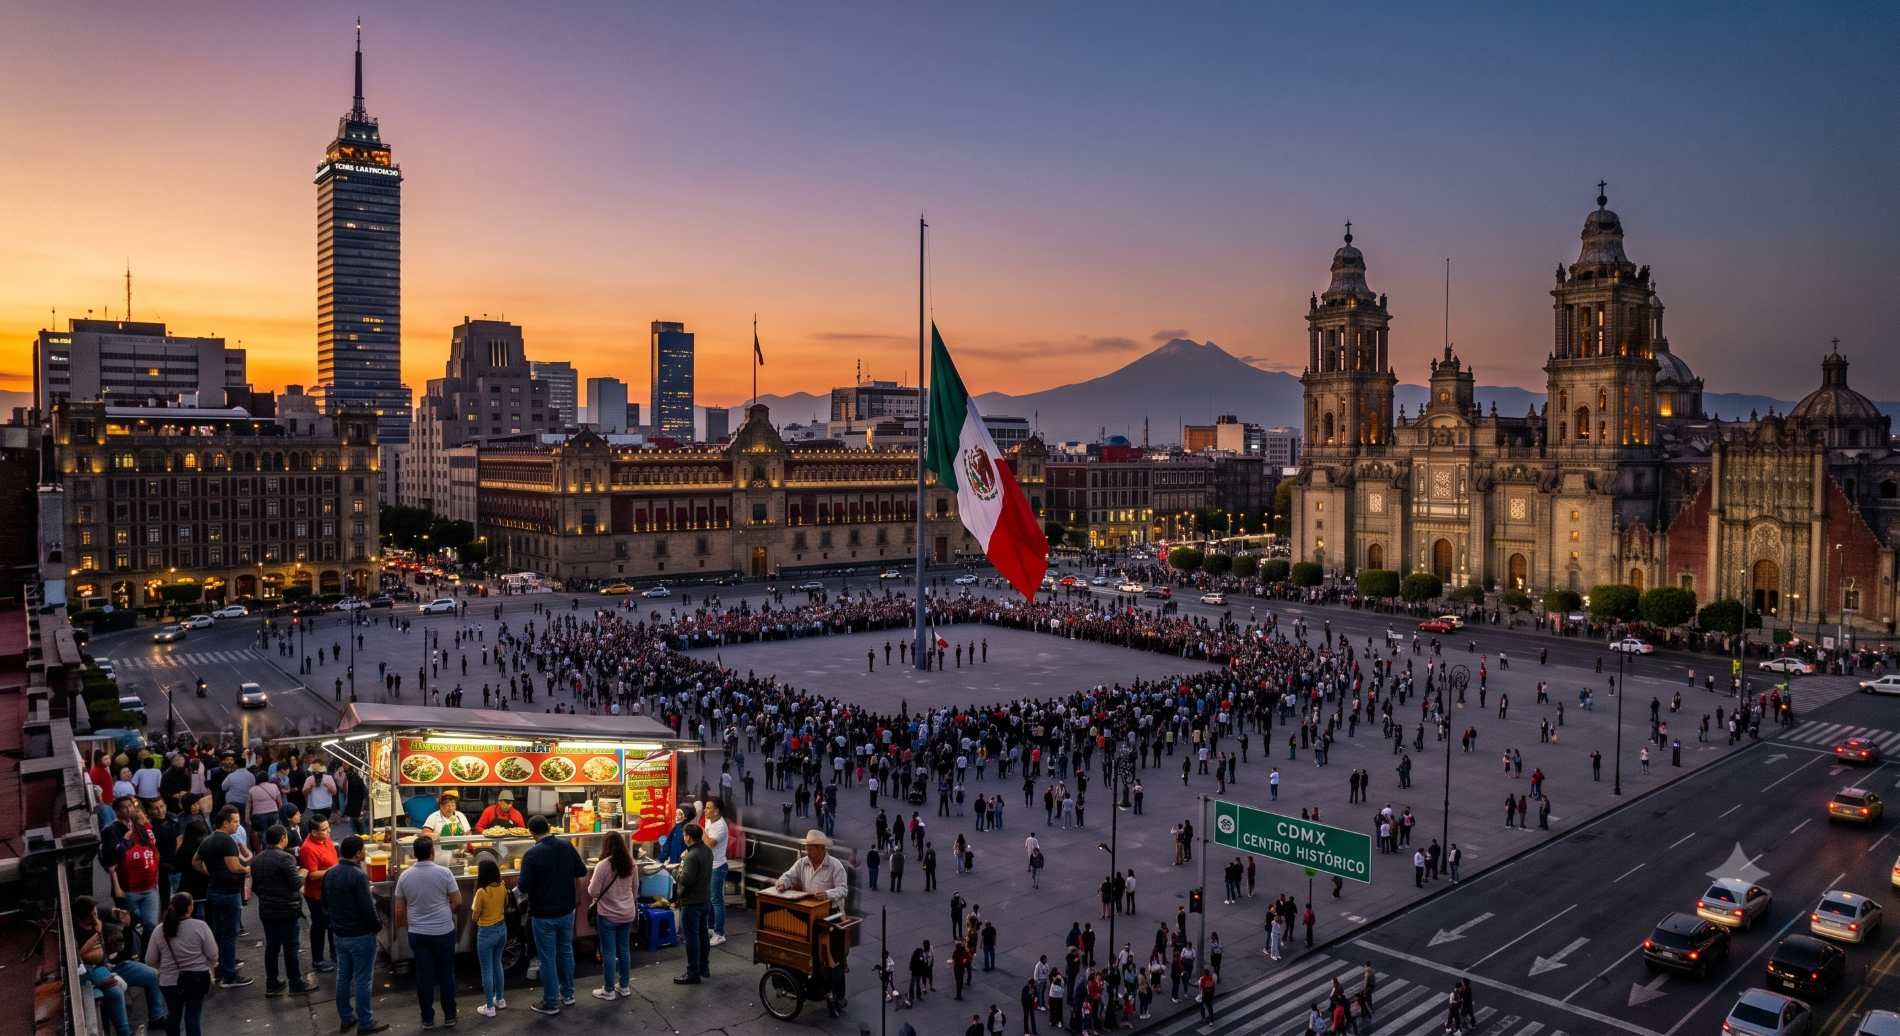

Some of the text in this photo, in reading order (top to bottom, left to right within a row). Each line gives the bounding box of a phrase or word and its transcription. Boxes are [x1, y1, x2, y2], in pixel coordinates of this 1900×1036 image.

[1277, 822, 1327, 847] CDMX
[1243, 832, 1365, 874] CENTRO HISTÓRICO
